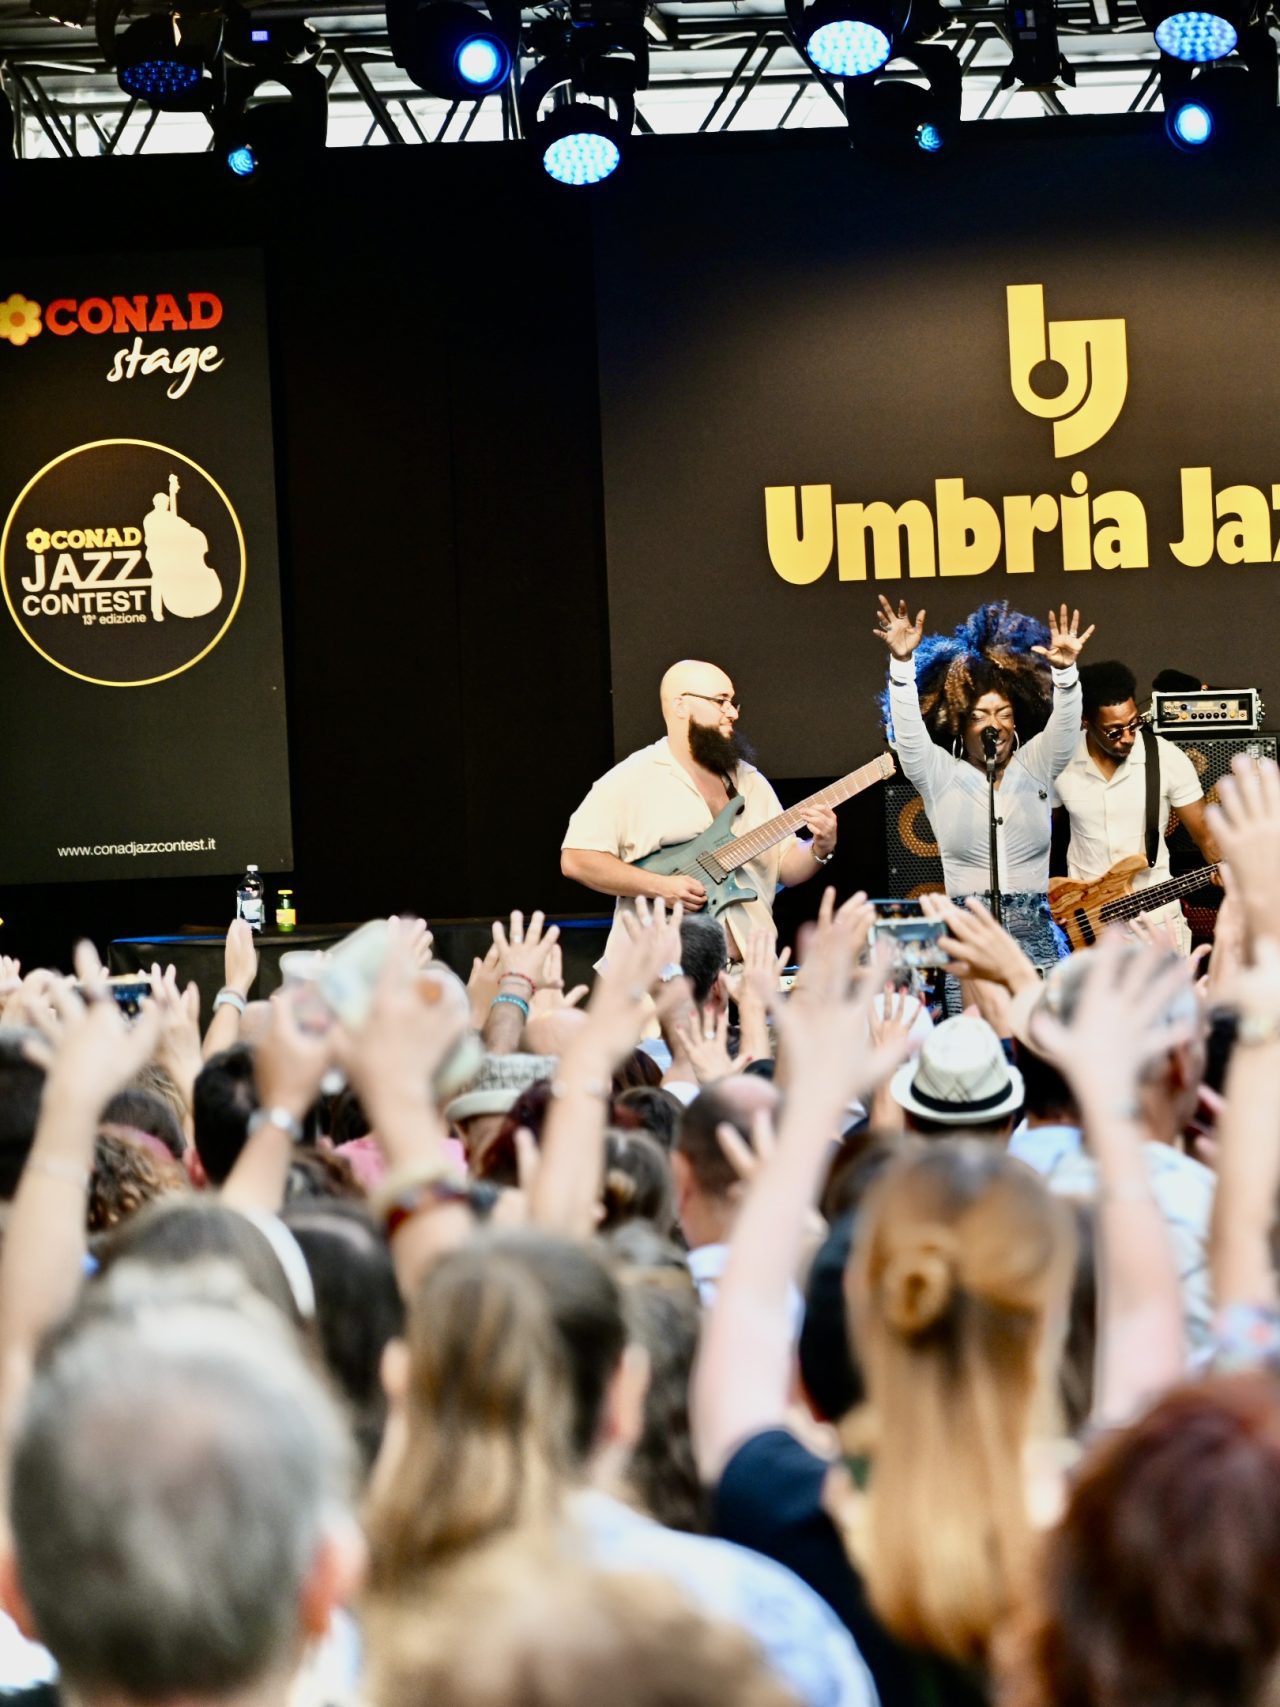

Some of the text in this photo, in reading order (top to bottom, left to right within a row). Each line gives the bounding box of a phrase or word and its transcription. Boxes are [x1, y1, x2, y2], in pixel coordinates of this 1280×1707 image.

[45, 292, 223, 336] CONAD
[106, 336, 225, 400] stage
[50, 526, 142, 550] CONAD
[764, 470, 1149, 586] Umbria
[21, 549, 146, 593] JAZZ
[22, 590, 147, 617] CONTEST
[99, 612, 147, 625] edizione
[57, 837, 216, 857] www.conadjazzcontest.it
